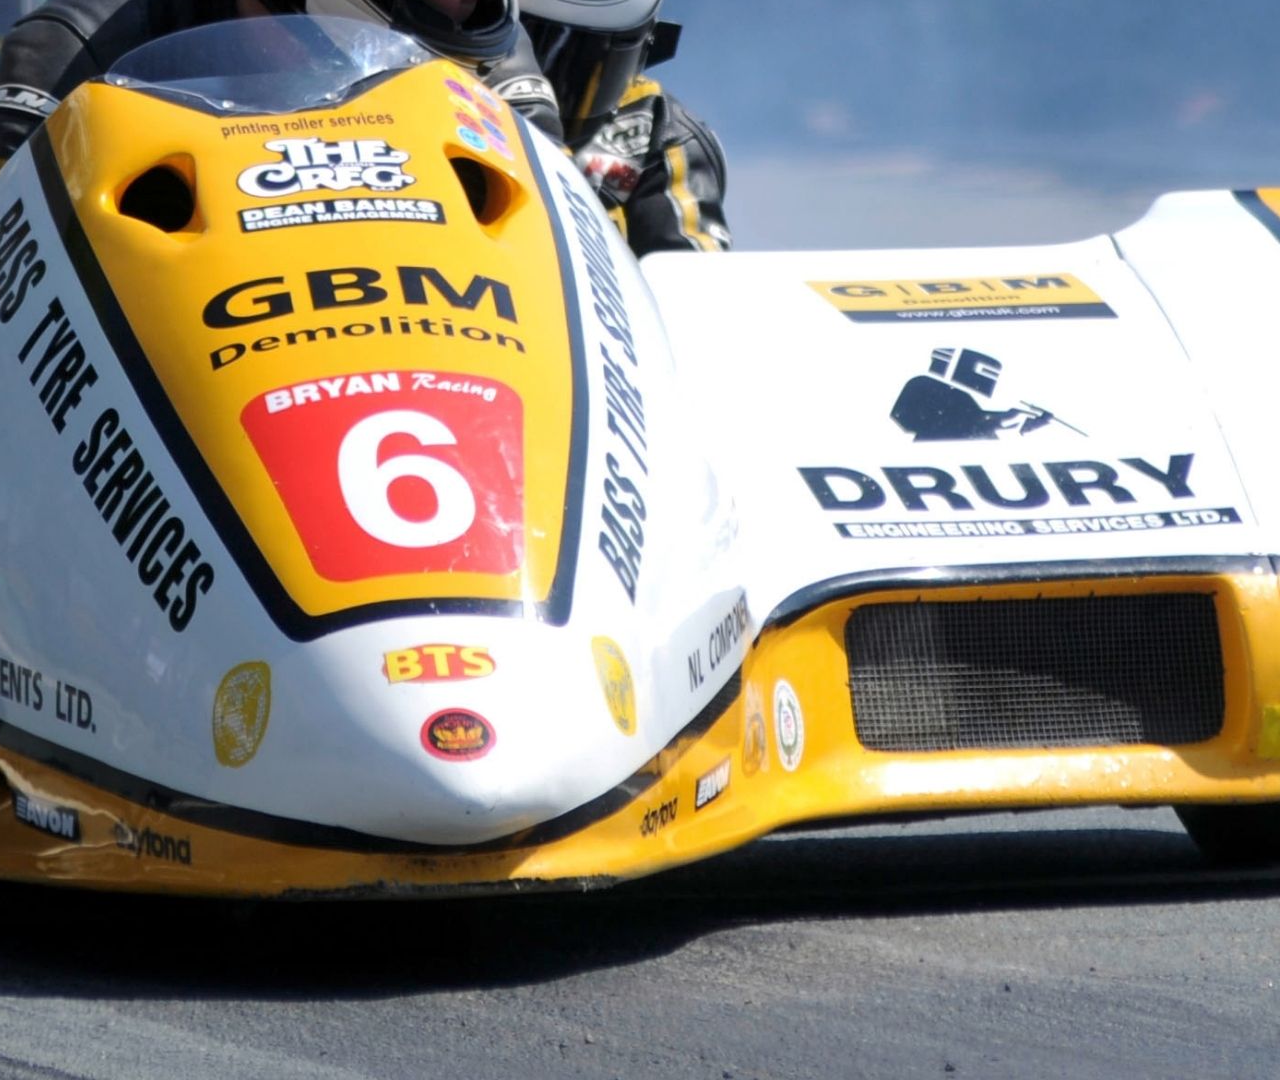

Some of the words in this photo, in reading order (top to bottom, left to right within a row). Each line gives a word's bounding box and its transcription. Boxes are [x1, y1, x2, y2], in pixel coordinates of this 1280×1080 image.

[221, 122, 281, 138] printing
[284, 115, 324, 132] roller
[329, 112, 394, 127] services
[264, 137, 410, 167] THE
[237, 161, 416, 197] CREG
[242, 201, 325, 221] DEAN
[333, 199, 438, 214] BANKS
[245, 214, 314, 231] ENGINE
[316, 211, 438, 222] MANAGEMENT
[556, 170, 638, 368] SERVICES
[201, 265, 520, 330] GBM
[895, 306, 1061, 320] www.gbmuk.com
[210, 316, 526, 371] Demolition
[264, 372, 401, 414] BRYAN
[410, 372, 497, 402] Racing
[600, 342, 648, 476] TYRE
[17, 296, 99, 435] TYRE
[71, 407, 215, 633] SERVICES
[337, 409, 476, 548] 6
[796, 453, 1196, 512] DRURY
[598, 452, 647, 607] BASS
[844, 520, 1022, 538] ENGINEERING
[1035, 513, 1165, 535] SERVICES
[1172, 508, 1231, 526] LTD.
[384, 645, 495, 684] BTS
[687, 648, 705, 693] NL
[55, 680, 97, 734] LTD.
